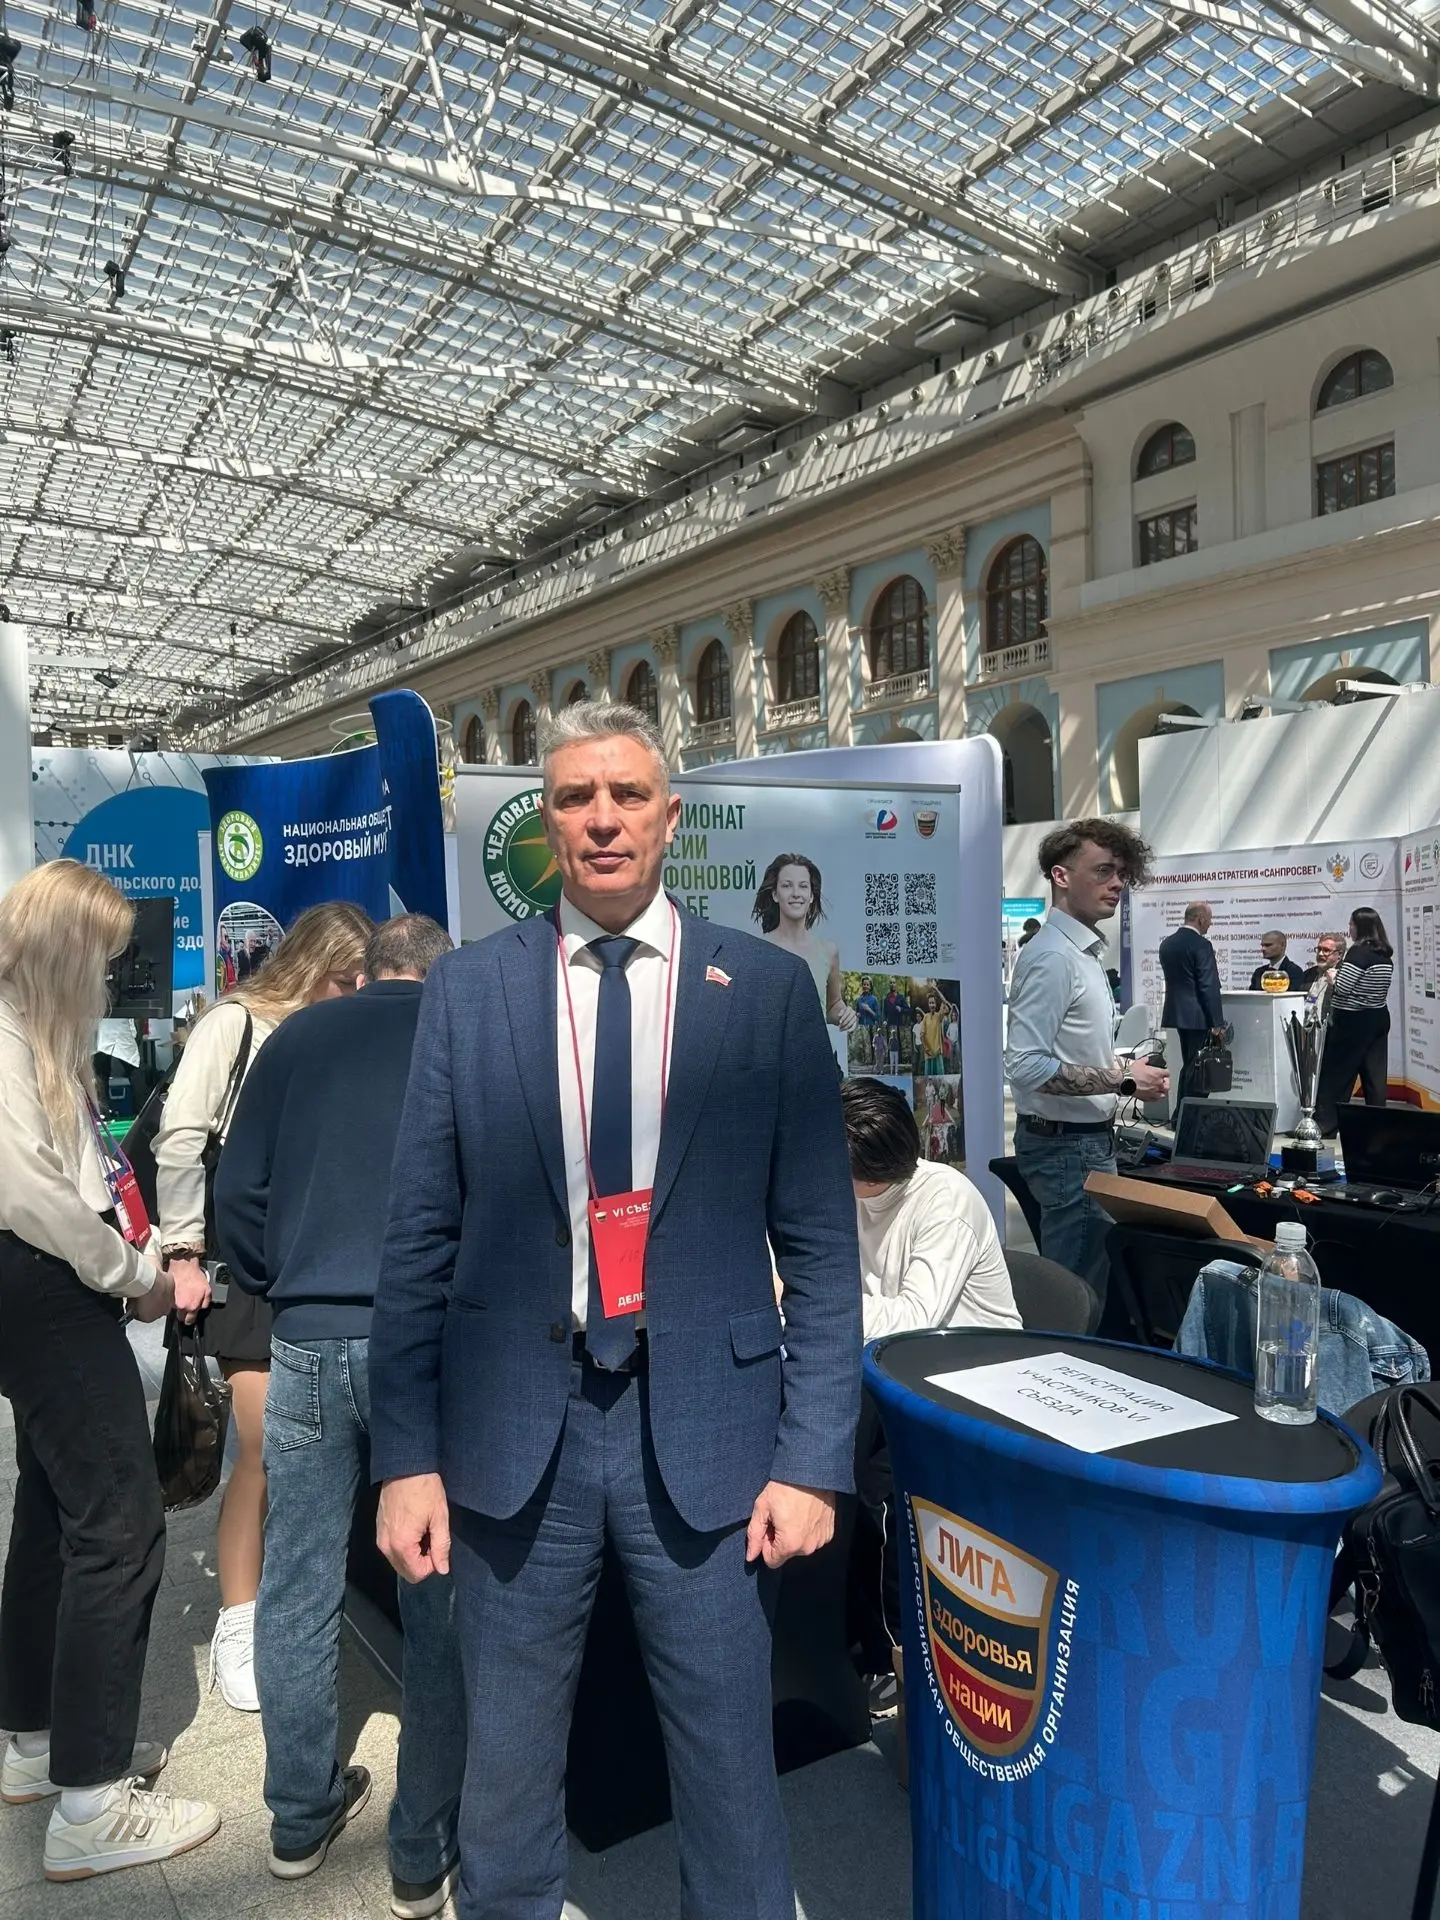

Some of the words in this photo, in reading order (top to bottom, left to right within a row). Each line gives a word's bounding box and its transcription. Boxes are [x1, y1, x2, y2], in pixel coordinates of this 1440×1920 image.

[283, 815, 367, 838] НАЦИОНАЛЬНАЯ
[680, 803, 746, 830] ИОНАТ
[85, 844, 135, 872] ДНК
[284, 831, 371, 867] ЗДОРОВЫЙ
[663, 833, 708, 860] СИИ
[109, 876, 175, 890] льского
[180, 877, 202, 892] до
[664, 859, 756, 890] ФОНОВОЙ
[1217, 868, 1259, 881] СТРАТЕГИЯ
[1260, 865, 1322, 878] «САНПРОСВЕТ»
[1230, 933, 1264, 941] ВОЗМОЖНО
[612, 1207, 624, 1217] VI
[1017, 1369, 1128, 1414] УЧАСТНИКОВ
[1127, 1412, 1151, 1422] VI
[1017, 1388, 1083, 1416] СЪЕЗДА
[1053, 1366, 1174, 1412] РЕГИСТРАЦИЯ
[937, 1525, 1017, 1606] ЛИГА
[903, 1490, 944, 1716] ОБЩЕРОССИЙСКАЯ
[944, 1716, 1046, 1783] ОБЩЕСТВЕННАЯ
[1042, 1578, 1081, 1745] ОРГАНИЗАЦИЯ
[949, 1672, 1013, 1734] нации
